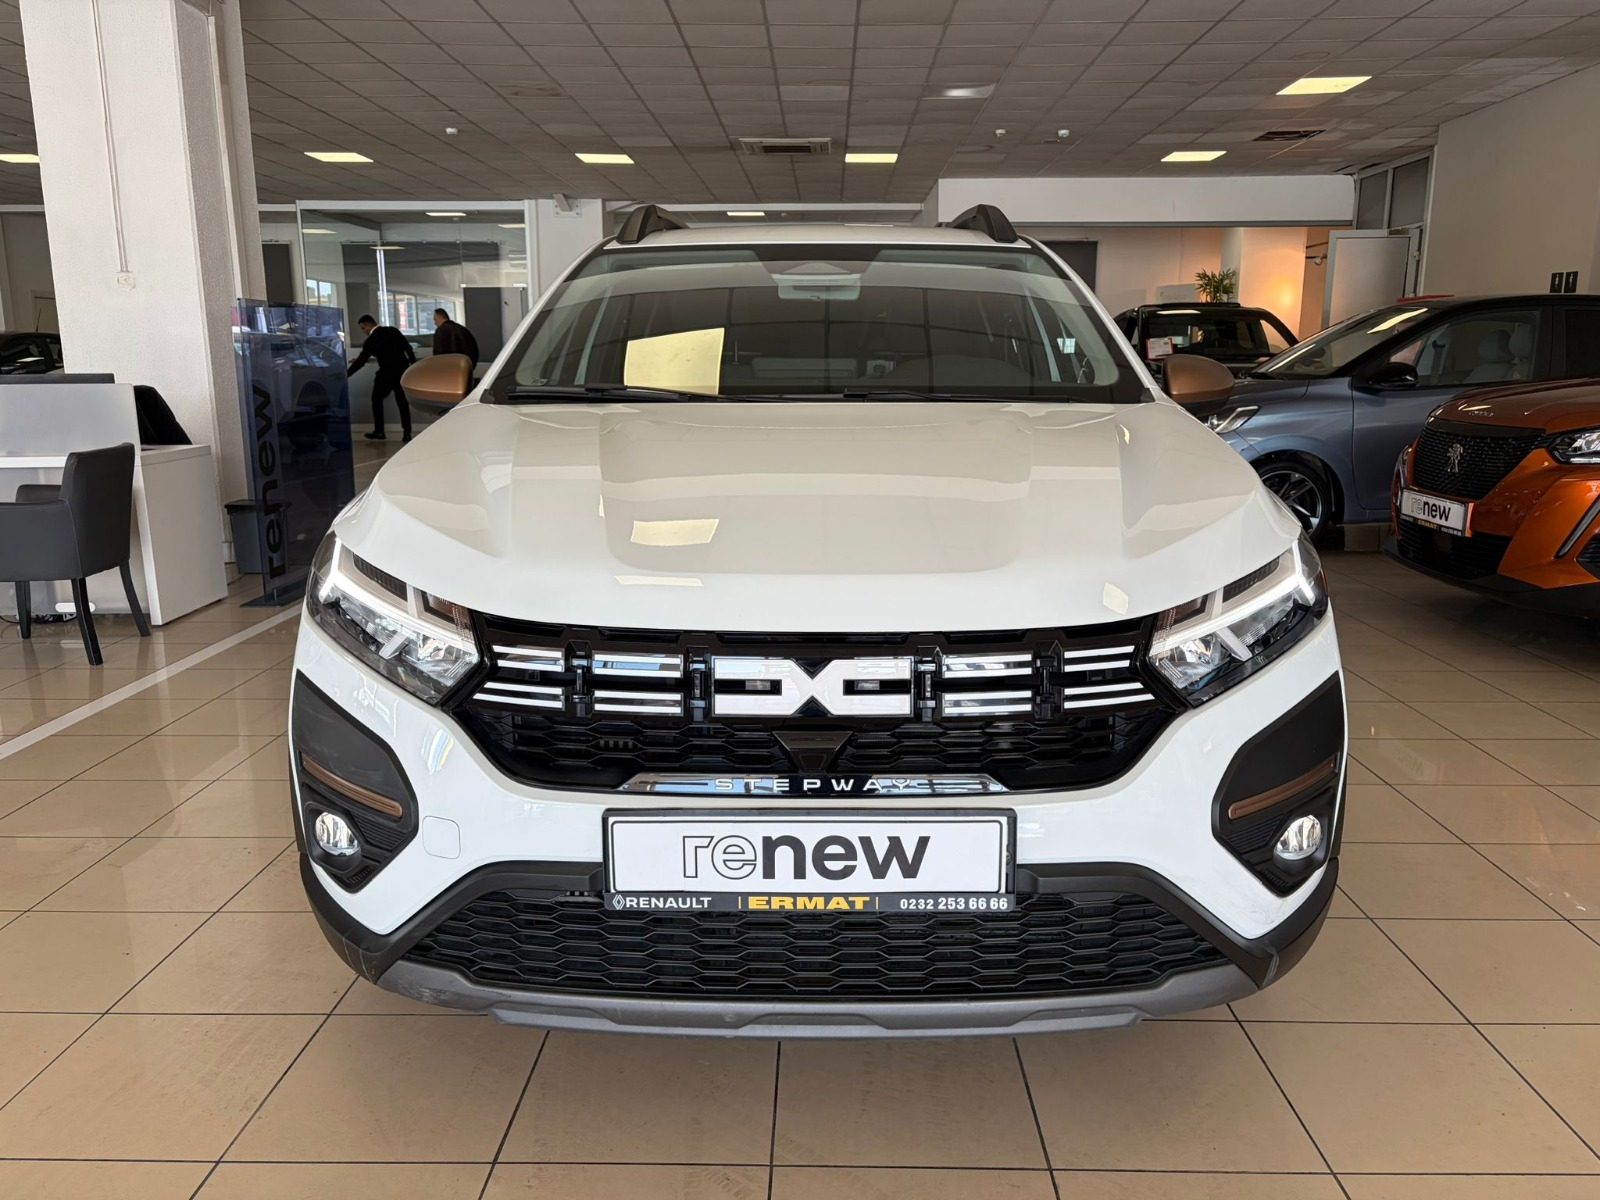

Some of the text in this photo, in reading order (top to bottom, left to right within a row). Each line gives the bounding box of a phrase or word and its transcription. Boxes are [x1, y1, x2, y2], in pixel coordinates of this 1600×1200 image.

[252, 384, 287, 579] renew
[1410, 497, 1451, 522] renew
[714, 778, 911, 792] STEPWAY
[682, 834, 931, 881] renew
[625, 897, 712, 909] RENAULT
[748, 896, 870, 910] ERMAT
[900, 897, 1008, 910] 0232 253 66 66
